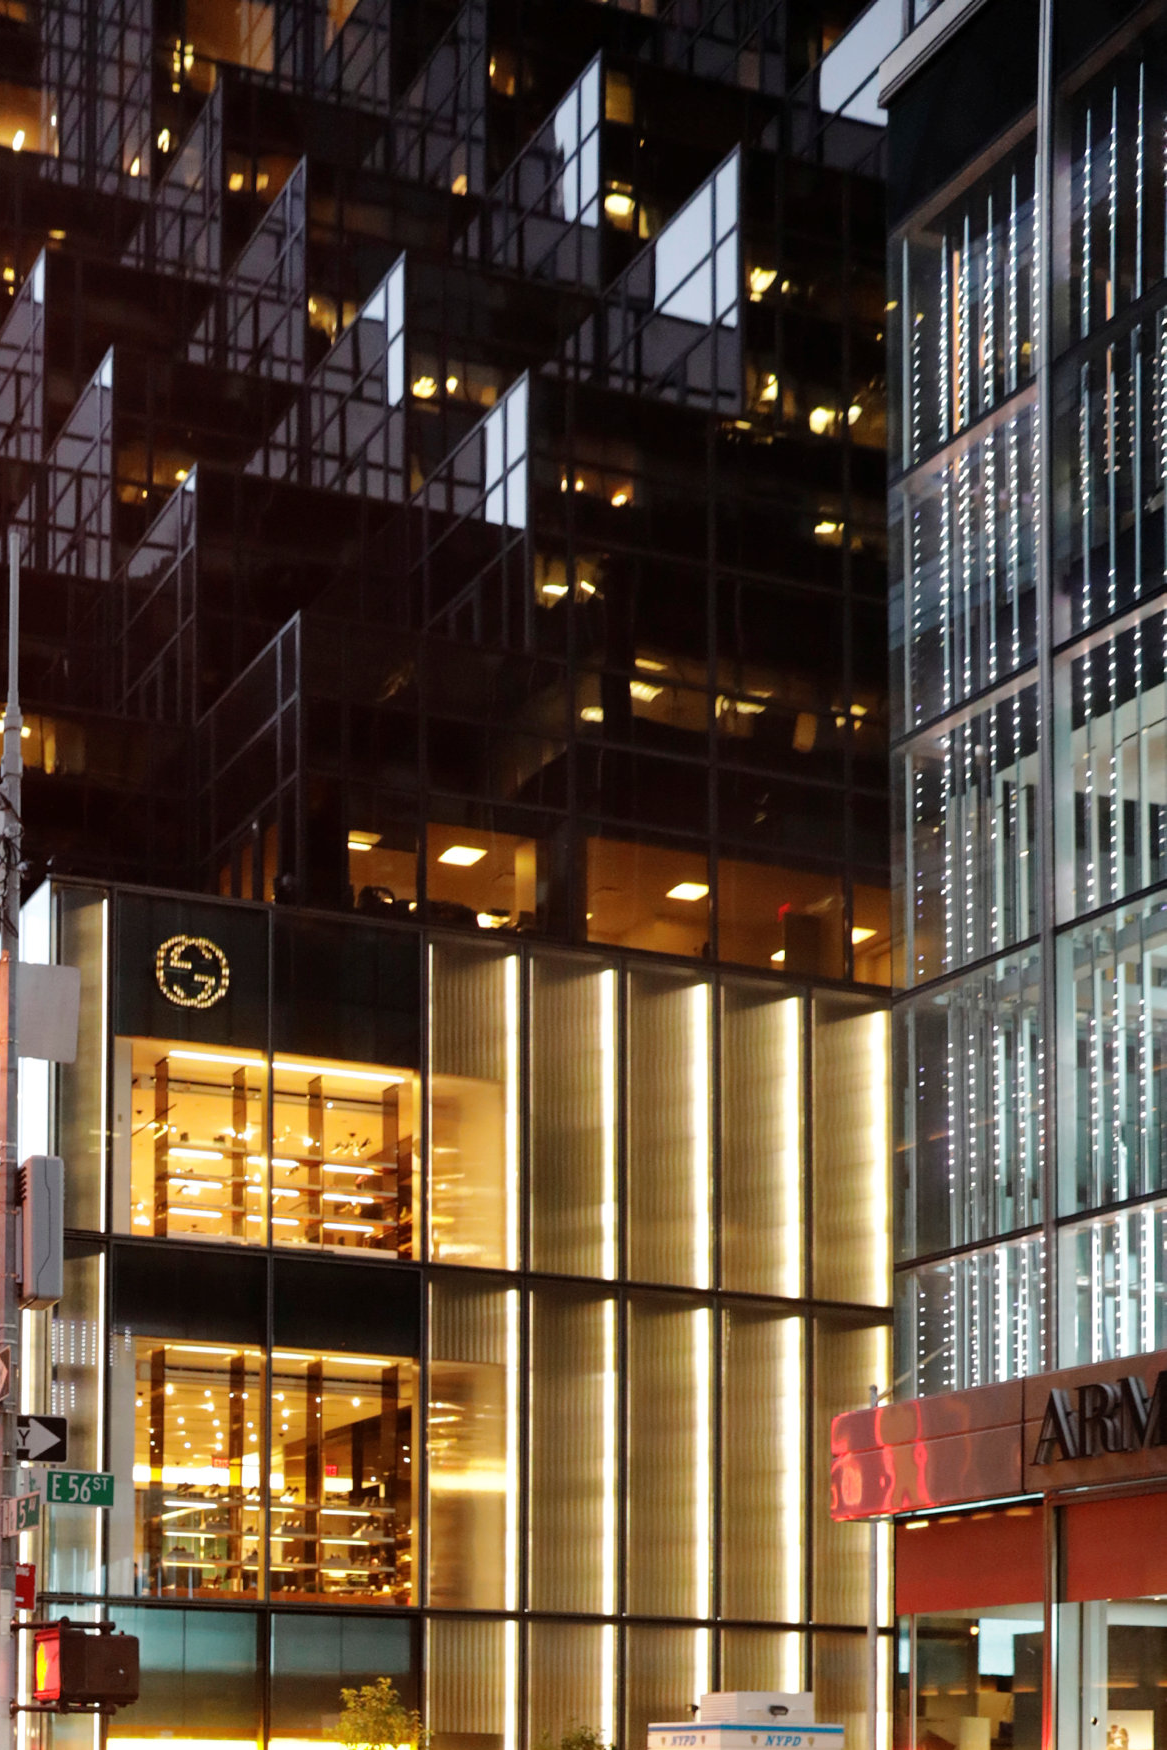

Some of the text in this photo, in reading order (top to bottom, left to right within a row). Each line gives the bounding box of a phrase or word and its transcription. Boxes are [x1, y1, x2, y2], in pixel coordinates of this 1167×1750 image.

[52, 1474, 63, 1501] E
[19, 1501, 26, 1529] 5
[671, 1734, 697, 1747] NYPD
[765, 1735, 802, 1747] NYPD
